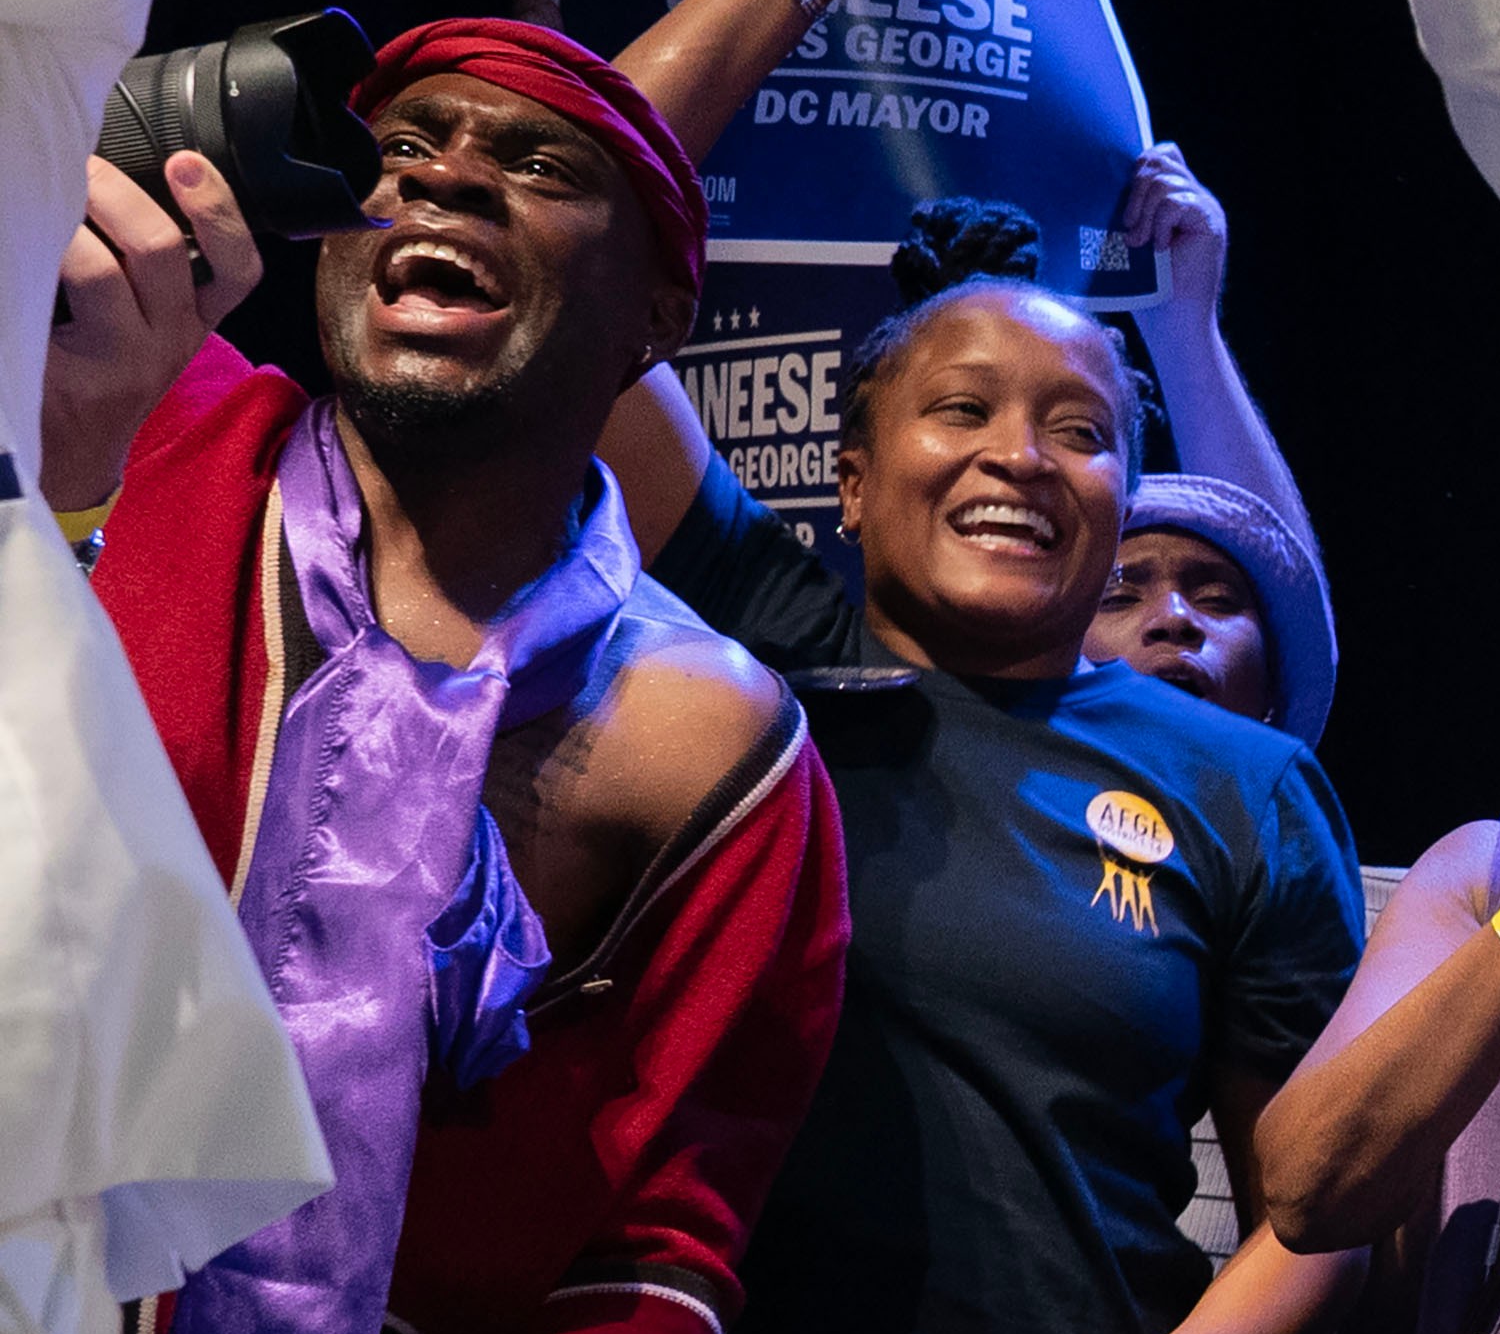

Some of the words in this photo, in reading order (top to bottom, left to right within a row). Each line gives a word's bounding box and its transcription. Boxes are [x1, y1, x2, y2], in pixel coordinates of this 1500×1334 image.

[845, 24, 1032, 82] GEORGE
[754, 89, 819, 125] DC
[828, 91, 991, 138] MAYOR
